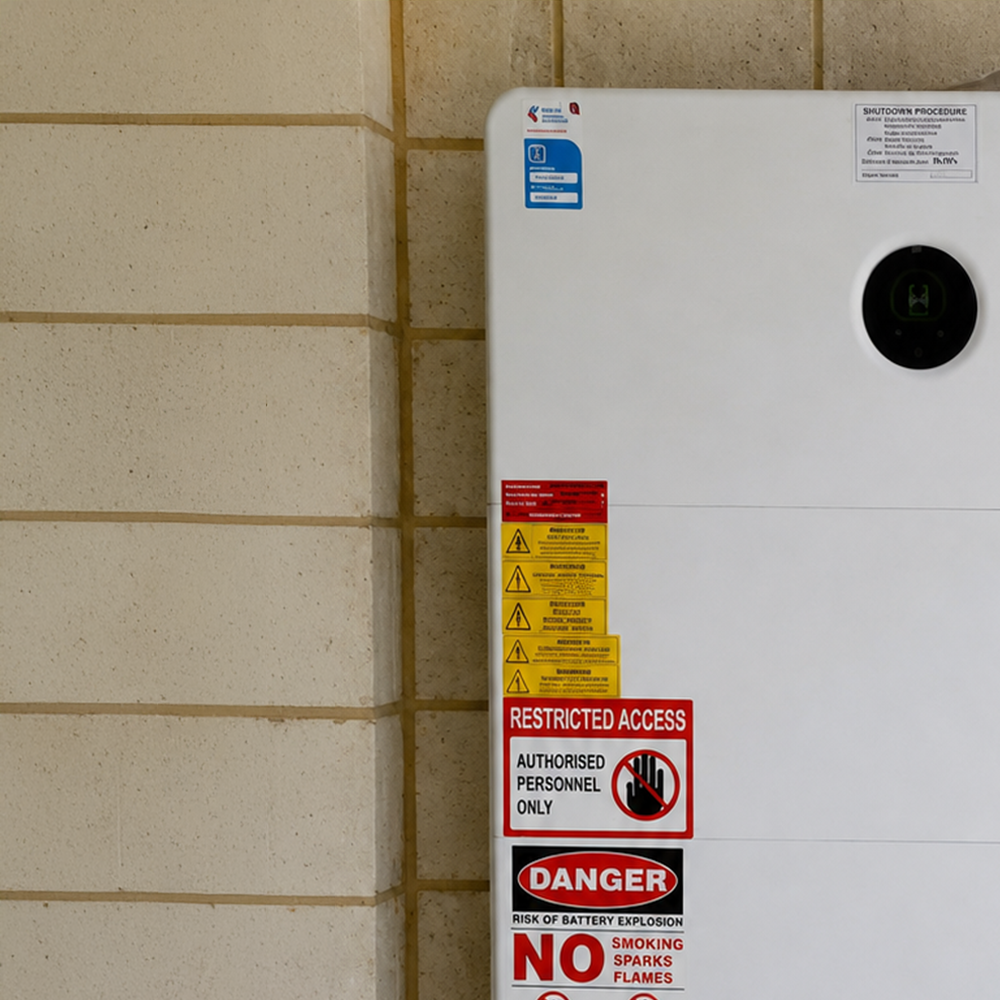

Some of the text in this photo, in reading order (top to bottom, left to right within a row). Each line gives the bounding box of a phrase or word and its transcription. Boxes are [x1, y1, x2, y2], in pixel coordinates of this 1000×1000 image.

[510, 707, 687, 731] RESTRICTED ACCESS
[517, 753, 605, 769] AUTHORISED
[517, 776, 601, 792] PERSONNEL
[517, 800, 553, 815] ONLY
[529, 867, 668, 892] DANGER
[512, 914, 683, 927] RISK OF BATTERY EXPLOSION
[611, 936, 684, 951] SMOKING
[513, 932, 605, 984] NO
[613, 954, 673, 968] SPARKS
[613, 971, 673, 985] FLAMES
